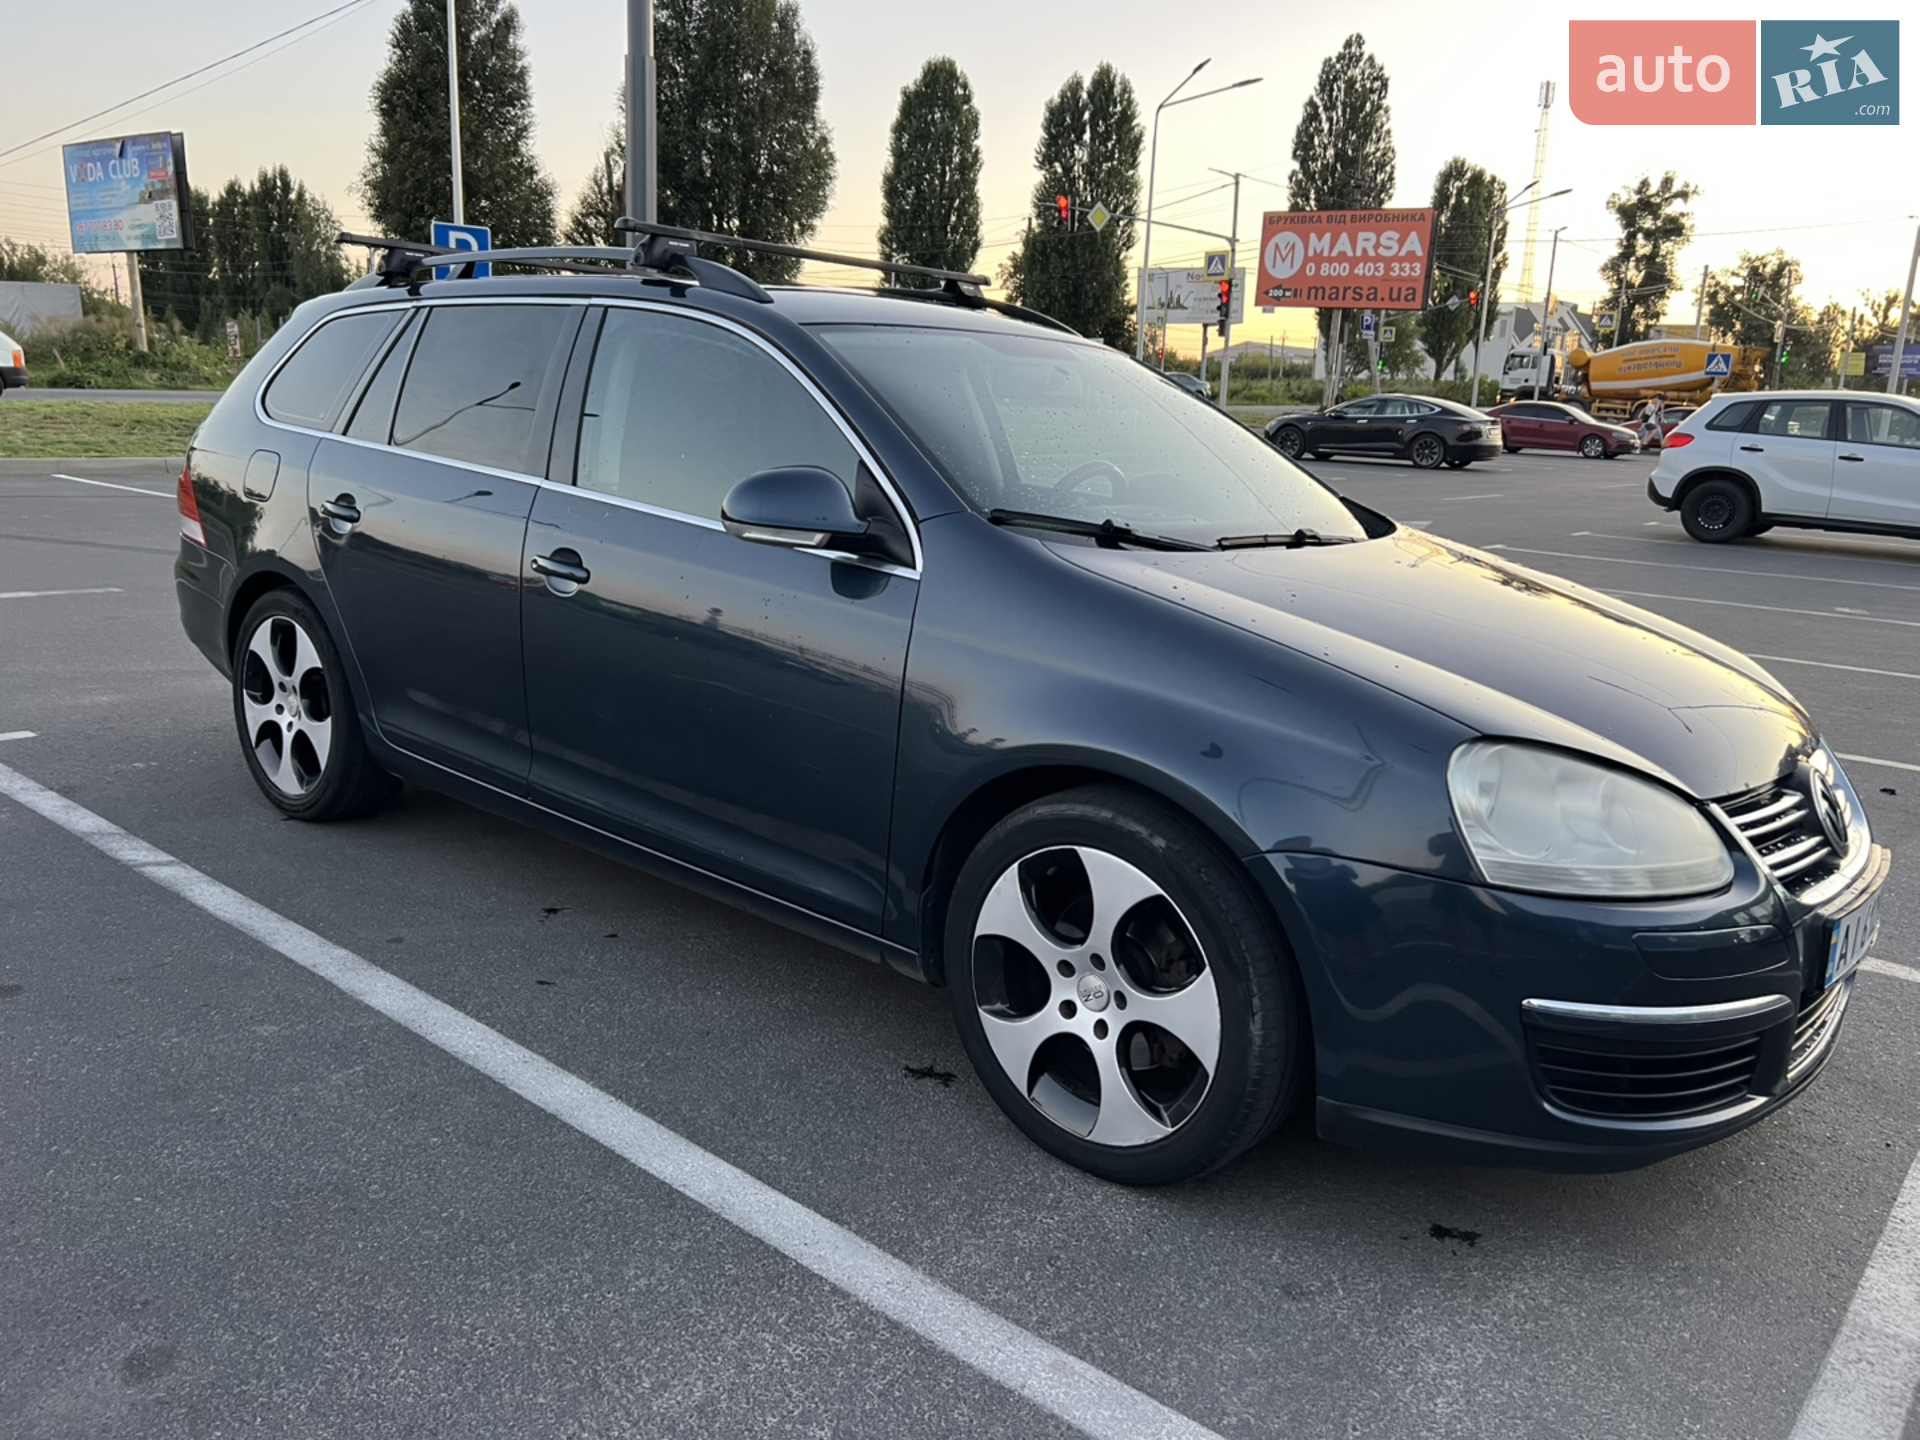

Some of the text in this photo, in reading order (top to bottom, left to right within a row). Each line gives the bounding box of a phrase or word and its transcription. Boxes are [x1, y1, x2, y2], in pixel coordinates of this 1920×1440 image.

[108, 158, 140, 179] CLUB
[1268, 213, 1426, 225] БРУКІВКА ВІД ВИРОБНИКА
[1307, 231, 1424, 257] MARSA
[1306, 262, 1421, 276] 0 800 403 333
[1268, 289, 1283, 297] 200
[1307, 285, 1417, 303] marsa.ua
[1363, 316, 1372, 329] P
